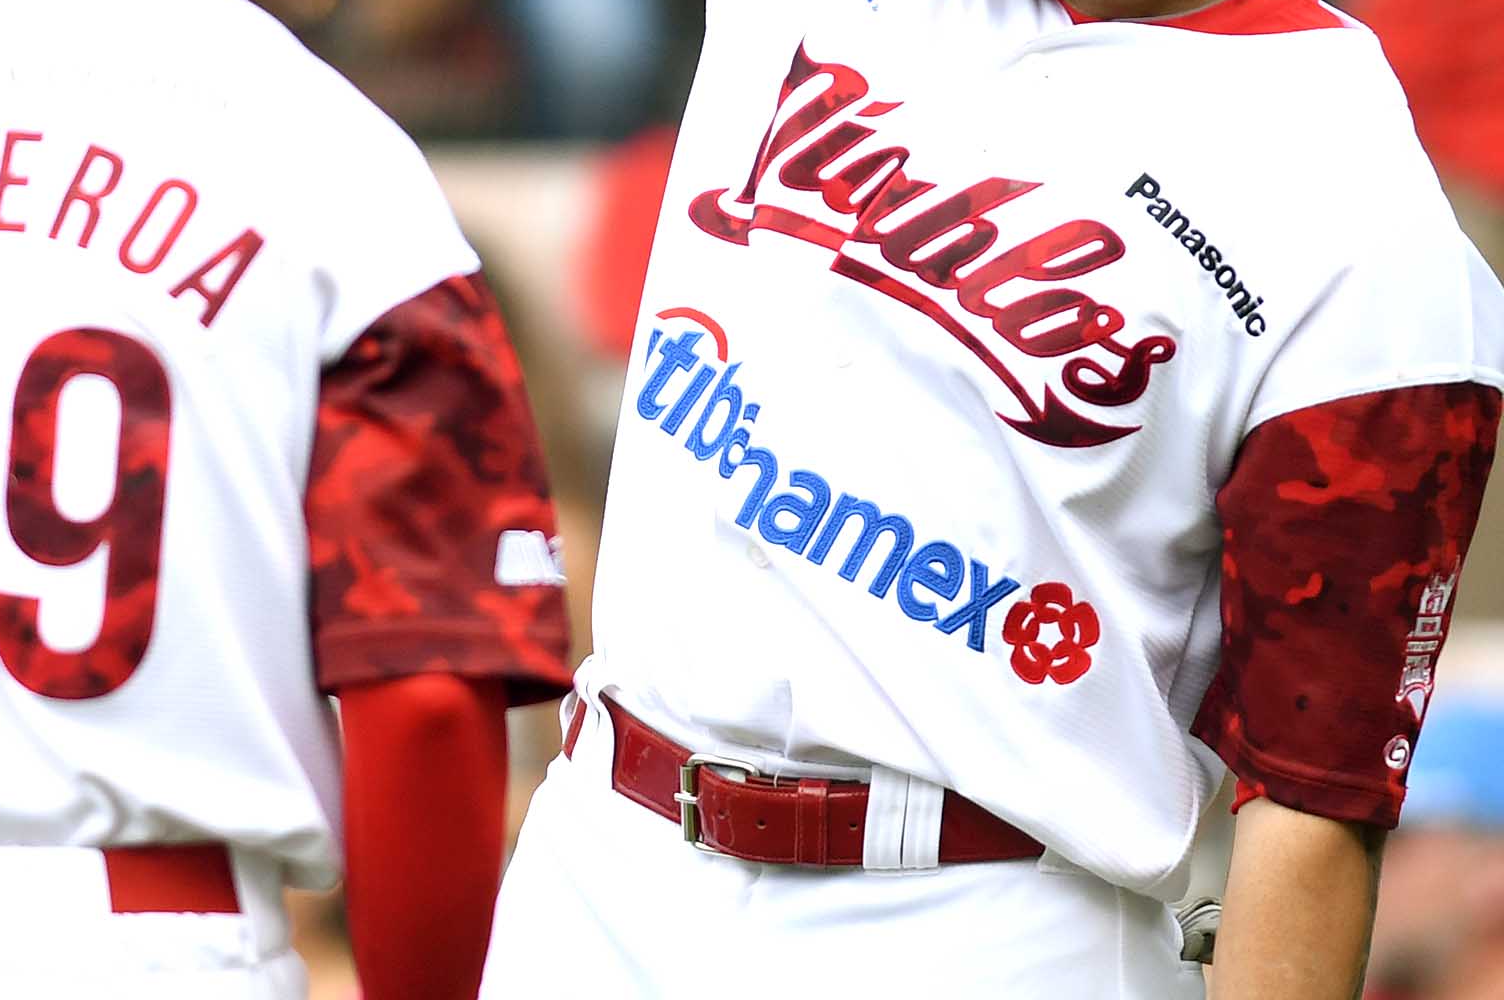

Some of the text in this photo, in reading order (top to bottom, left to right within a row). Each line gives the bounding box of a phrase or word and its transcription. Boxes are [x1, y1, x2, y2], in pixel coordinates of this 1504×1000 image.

[688, 35, 1177, 412] Diablos
[1124, 171, 1267, 338] Panasonic
[636, 307, 1021, 654] tibanamex
